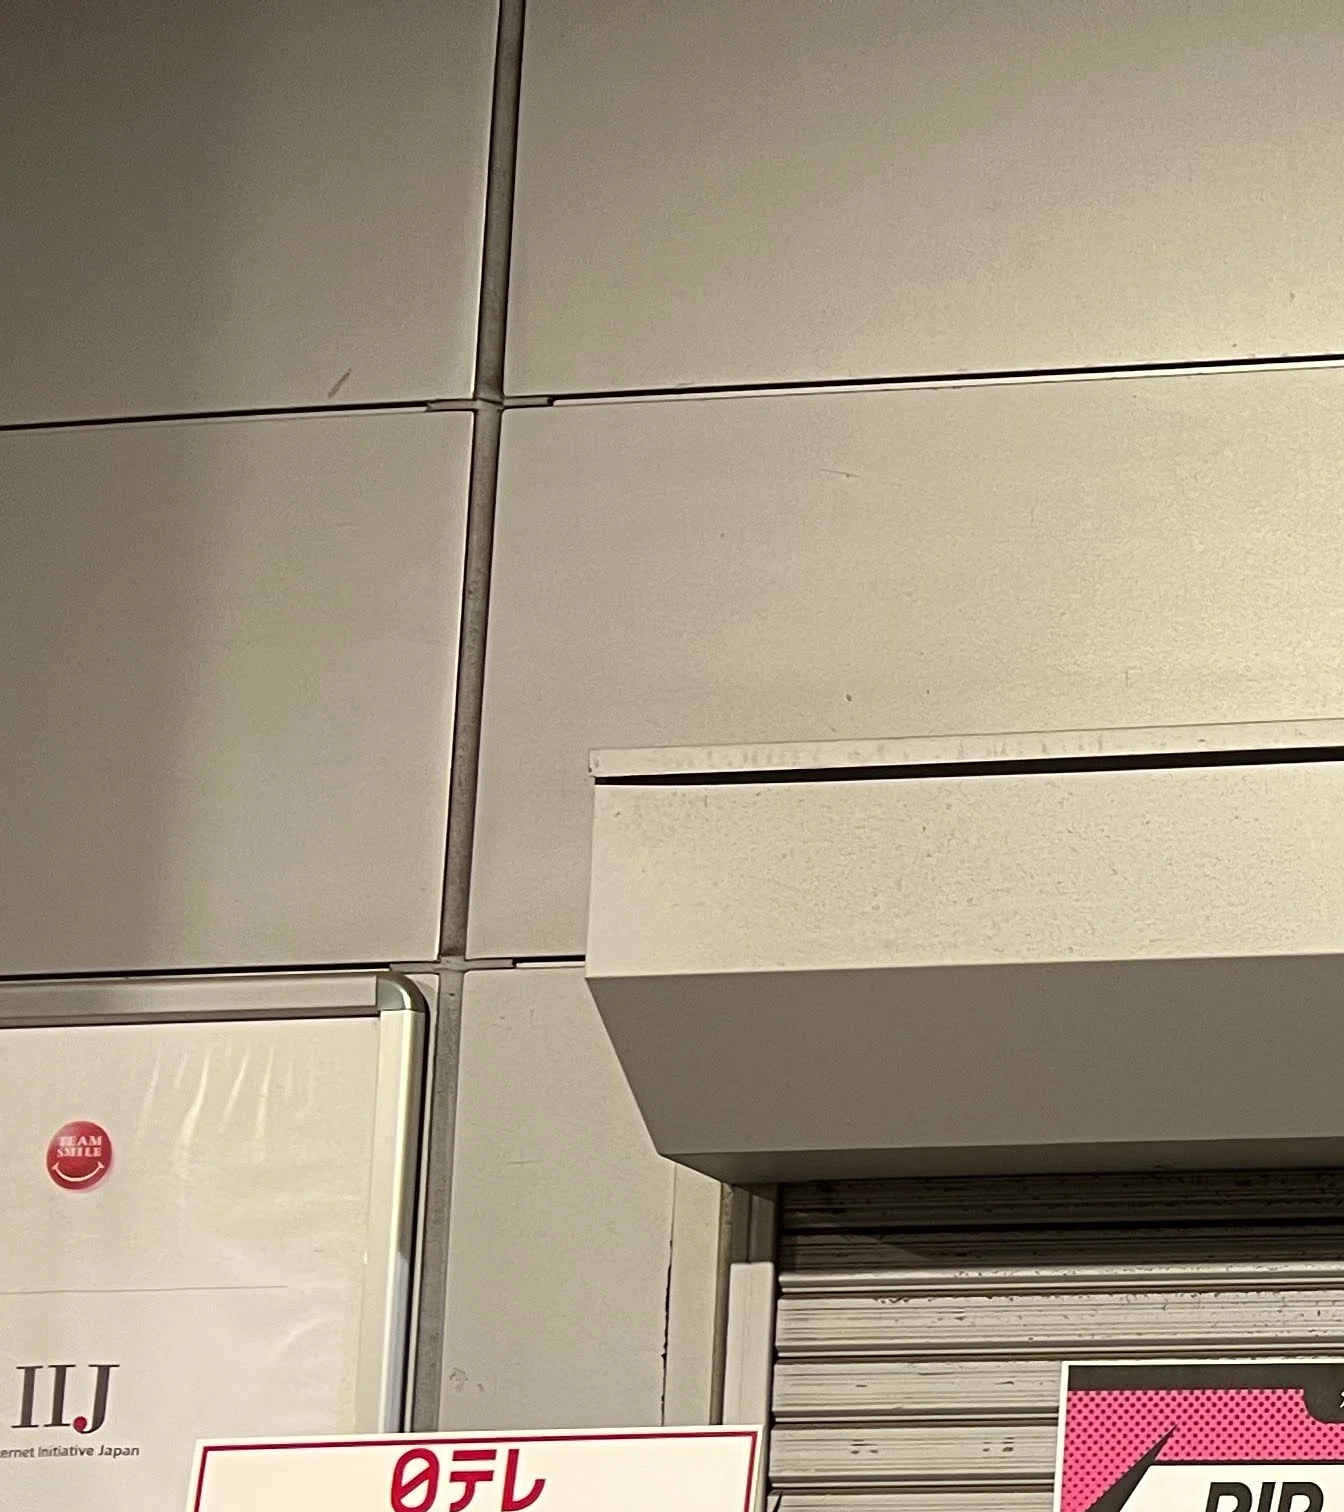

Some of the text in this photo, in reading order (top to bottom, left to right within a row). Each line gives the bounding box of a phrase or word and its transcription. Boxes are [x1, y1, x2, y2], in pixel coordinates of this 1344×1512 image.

[58, 1135, 103, 1147] TEAM
[11, 1363, 121, 1435] IIJ
[0, 1445, 140, 1459] ernet Initiative Japan
